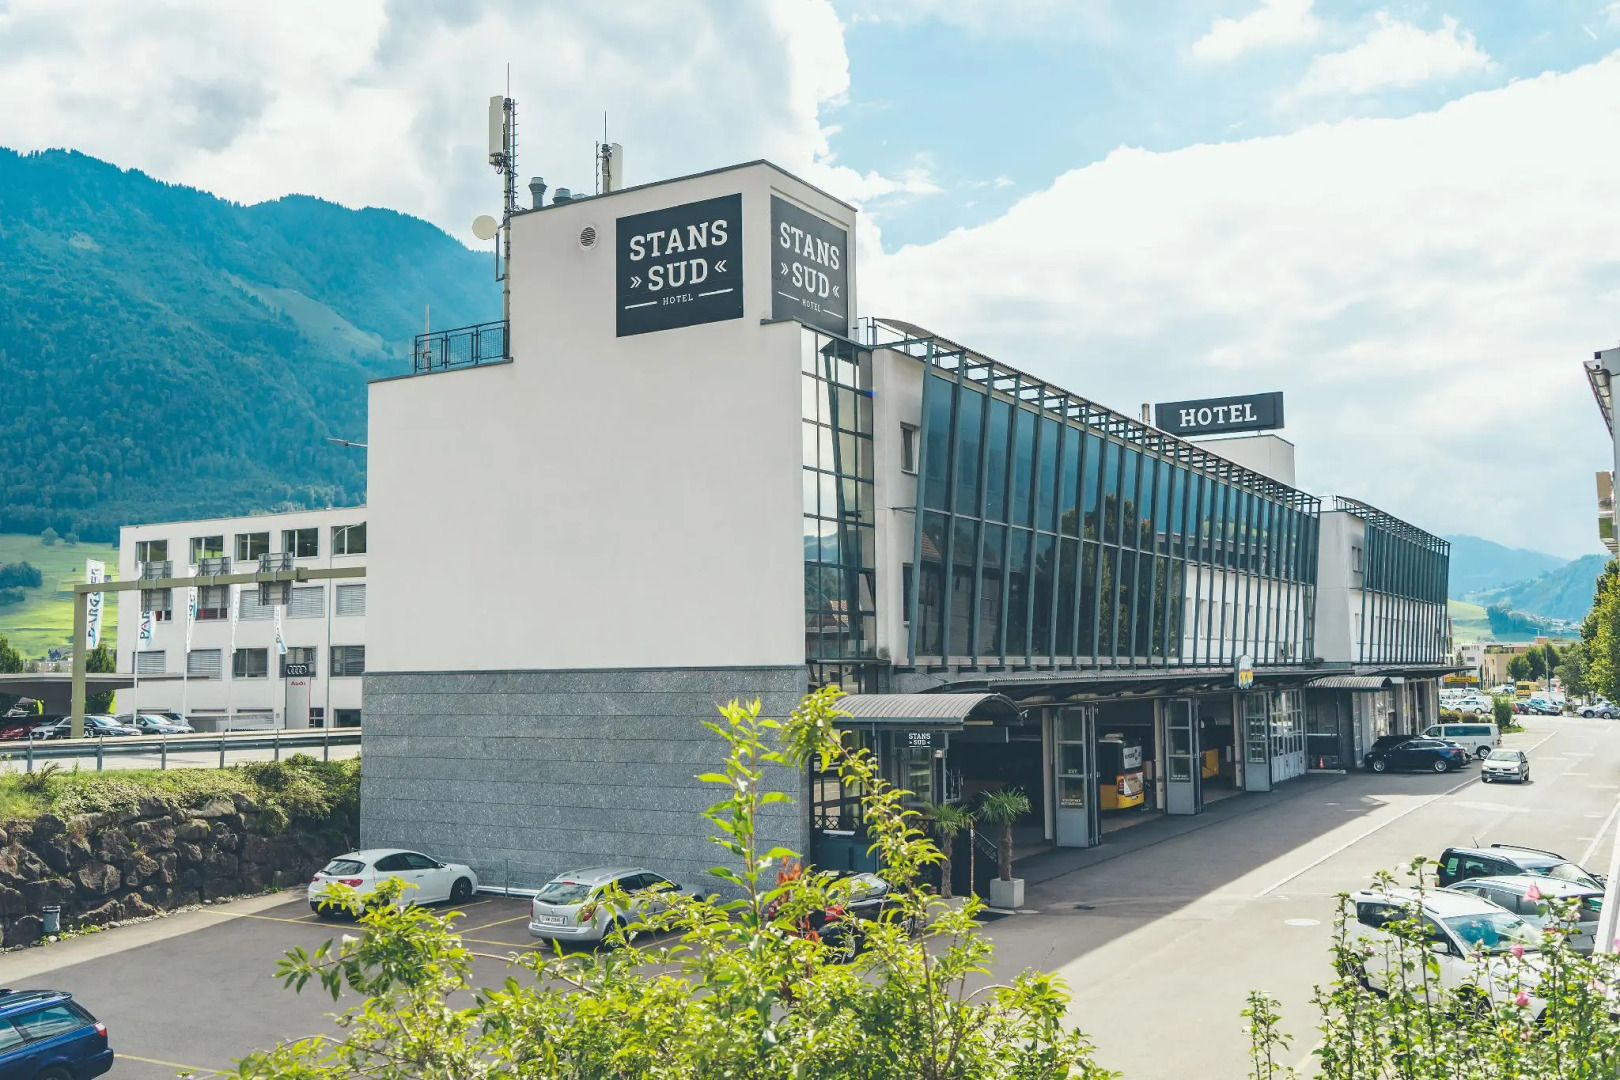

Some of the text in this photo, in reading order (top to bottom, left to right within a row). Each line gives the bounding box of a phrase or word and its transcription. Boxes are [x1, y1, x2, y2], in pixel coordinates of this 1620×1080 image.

[629, 219, 728, 261] STANS
[780, 221, 840, 270] STANS
[662, 293, 694, 306] HOTEL
[801, 298, 821, 313] HOTEL
[1179, 403, 1257, 427] HOTEL
[908, 732, 931, 740] STANS
